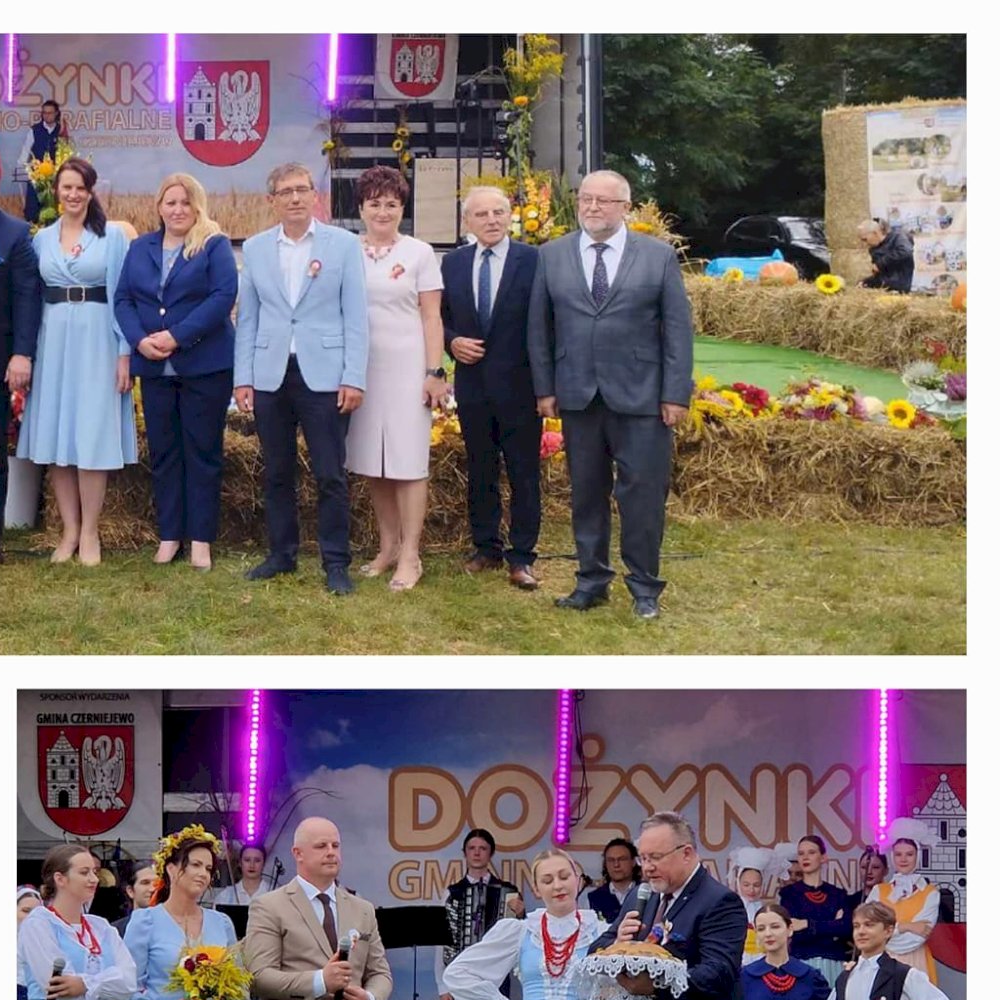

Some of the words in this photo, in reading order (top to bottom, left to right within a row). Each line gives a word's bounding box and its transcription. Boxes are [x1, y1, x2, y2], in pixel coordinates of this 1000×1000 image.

[40, 692, 77, 701] SPONSOR
[78, 692, 131, 701] WYDARZENIA
[36, 713, 68, 724] GMINA
[70, 713, 135, 724] CZERNIEJEWO
